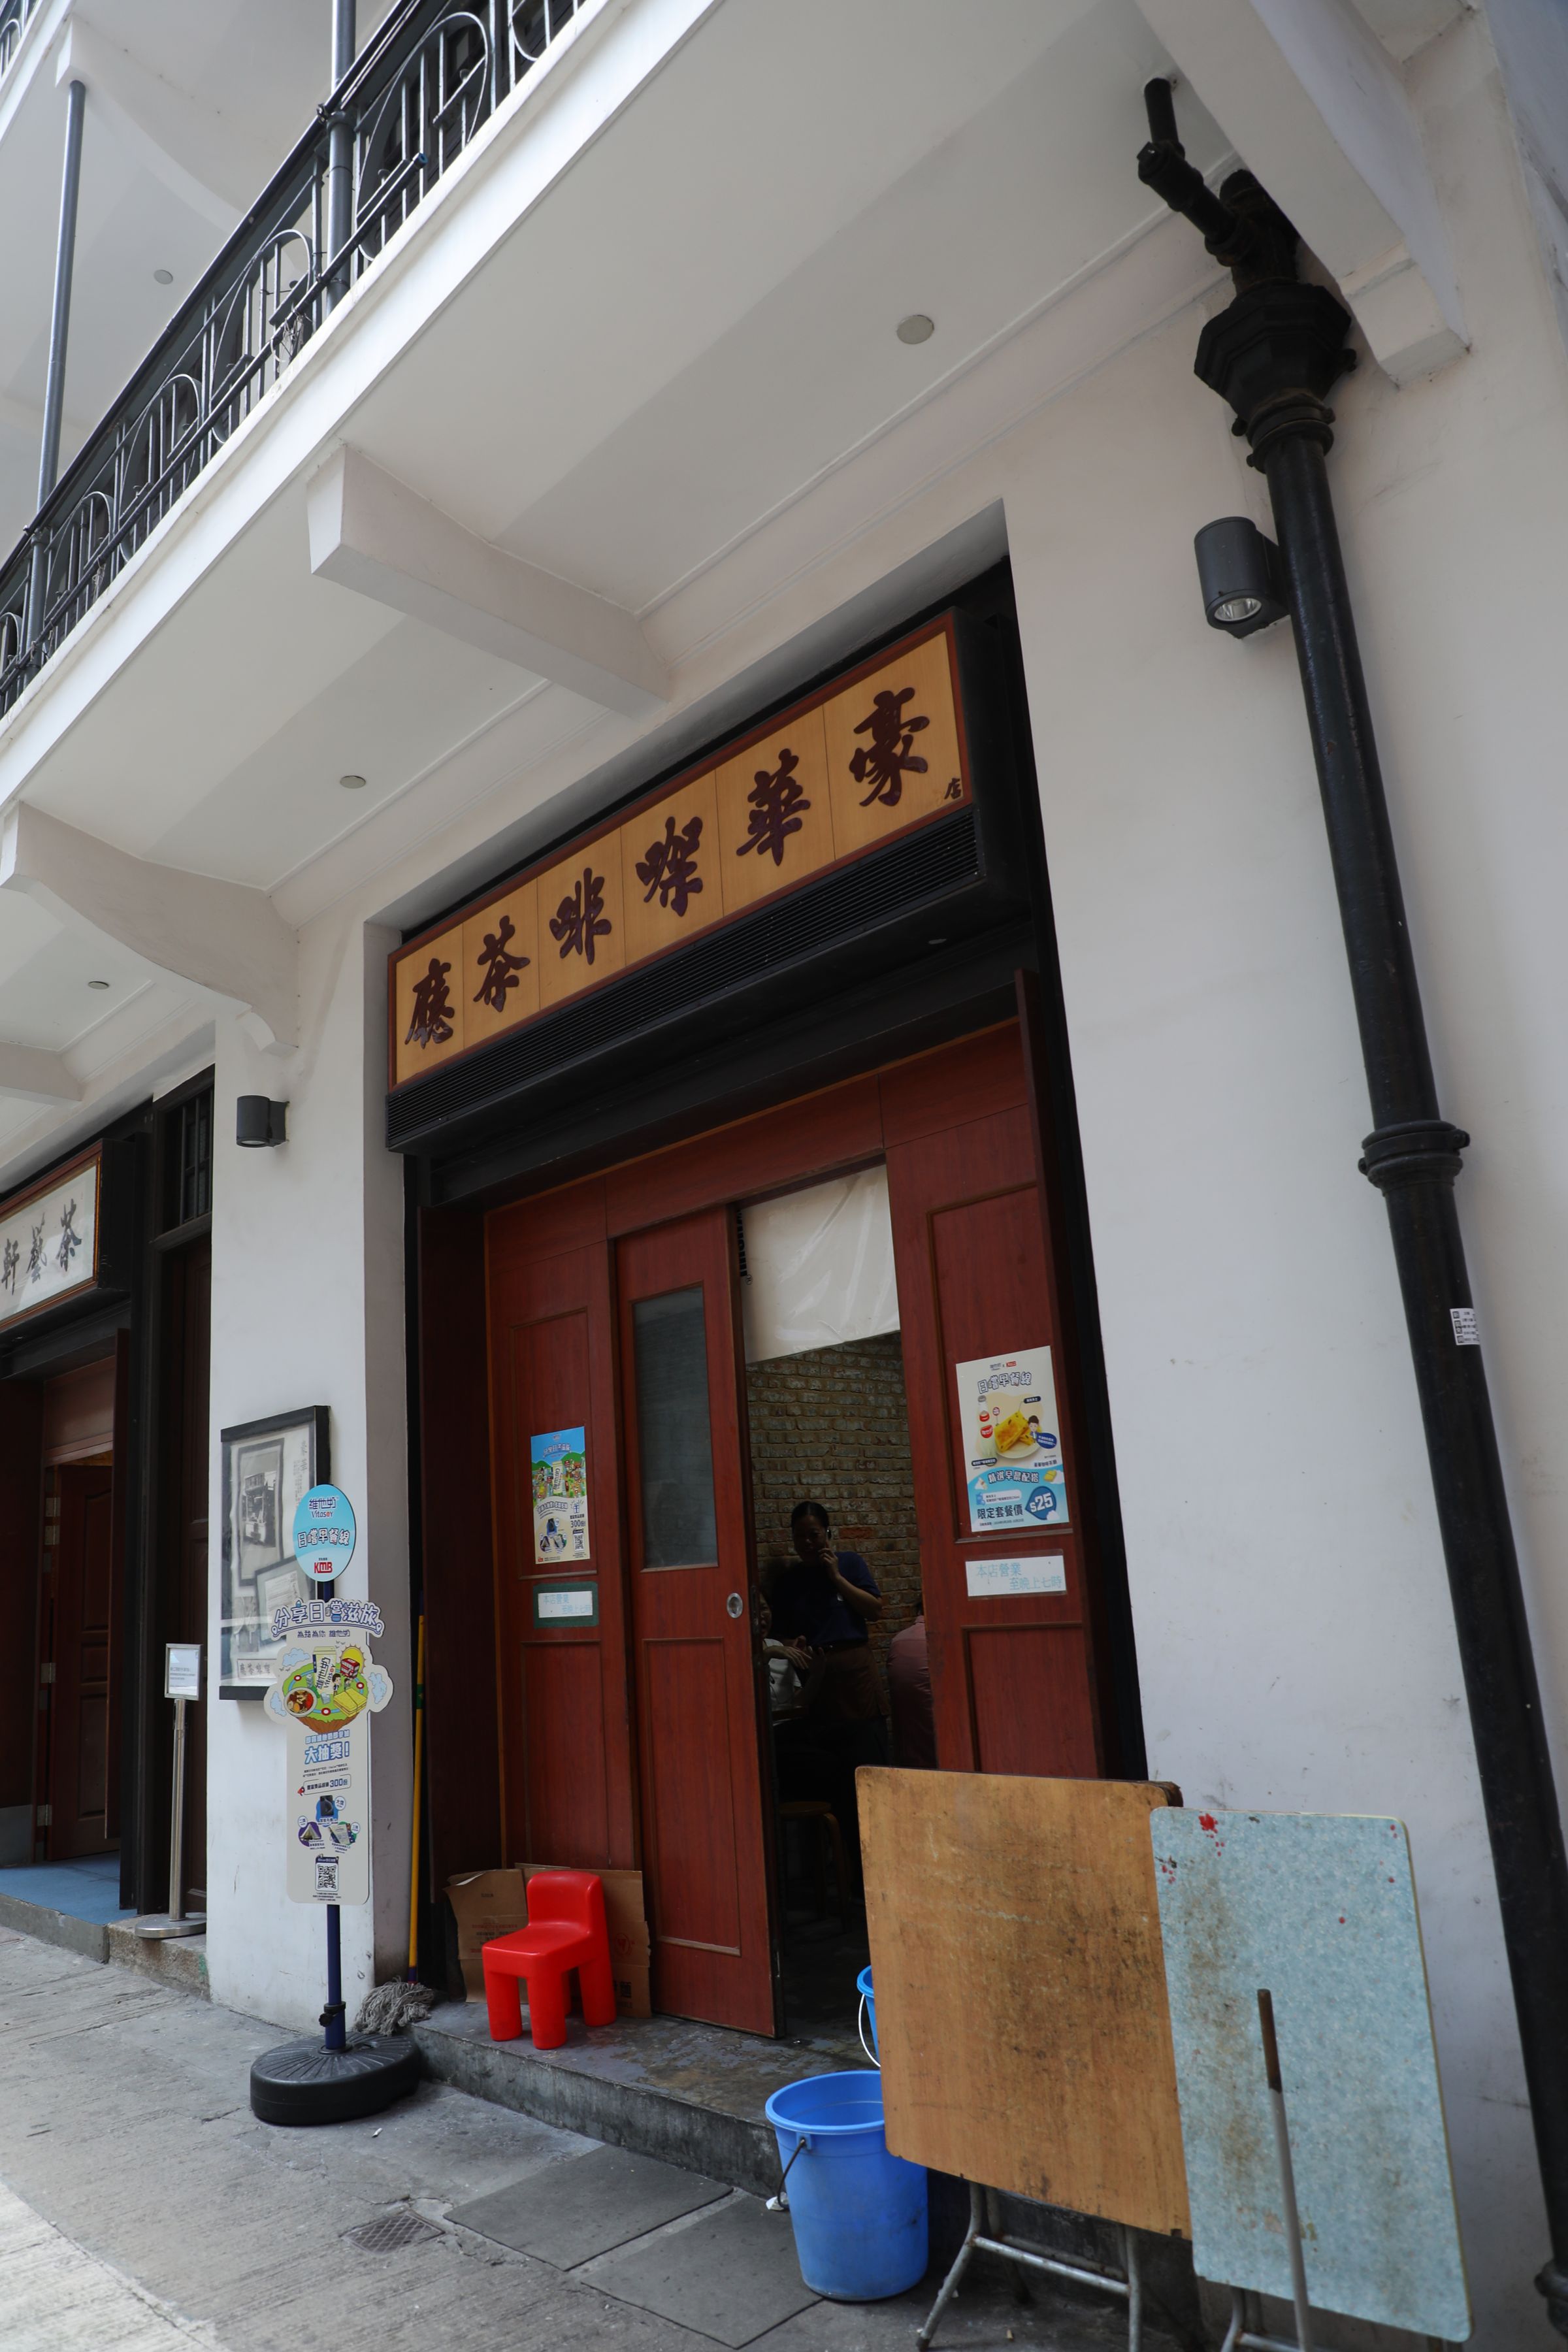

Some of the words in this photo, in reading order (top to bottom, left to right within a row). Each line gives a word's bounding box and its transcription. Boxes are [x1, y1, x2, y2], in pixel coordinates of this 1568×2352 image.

[309, 1497, 336, 1509] 維他奶
[1029, 1492, 1054, 1513] $25
[977, 1504, 1024, 1520] 限定套餐價
[314, 1562, 333, 1574] KMB
[977, 1562, 1022, 1578] 本店營業
[1009, 1575, 1062, 1590] 至晚上七時
